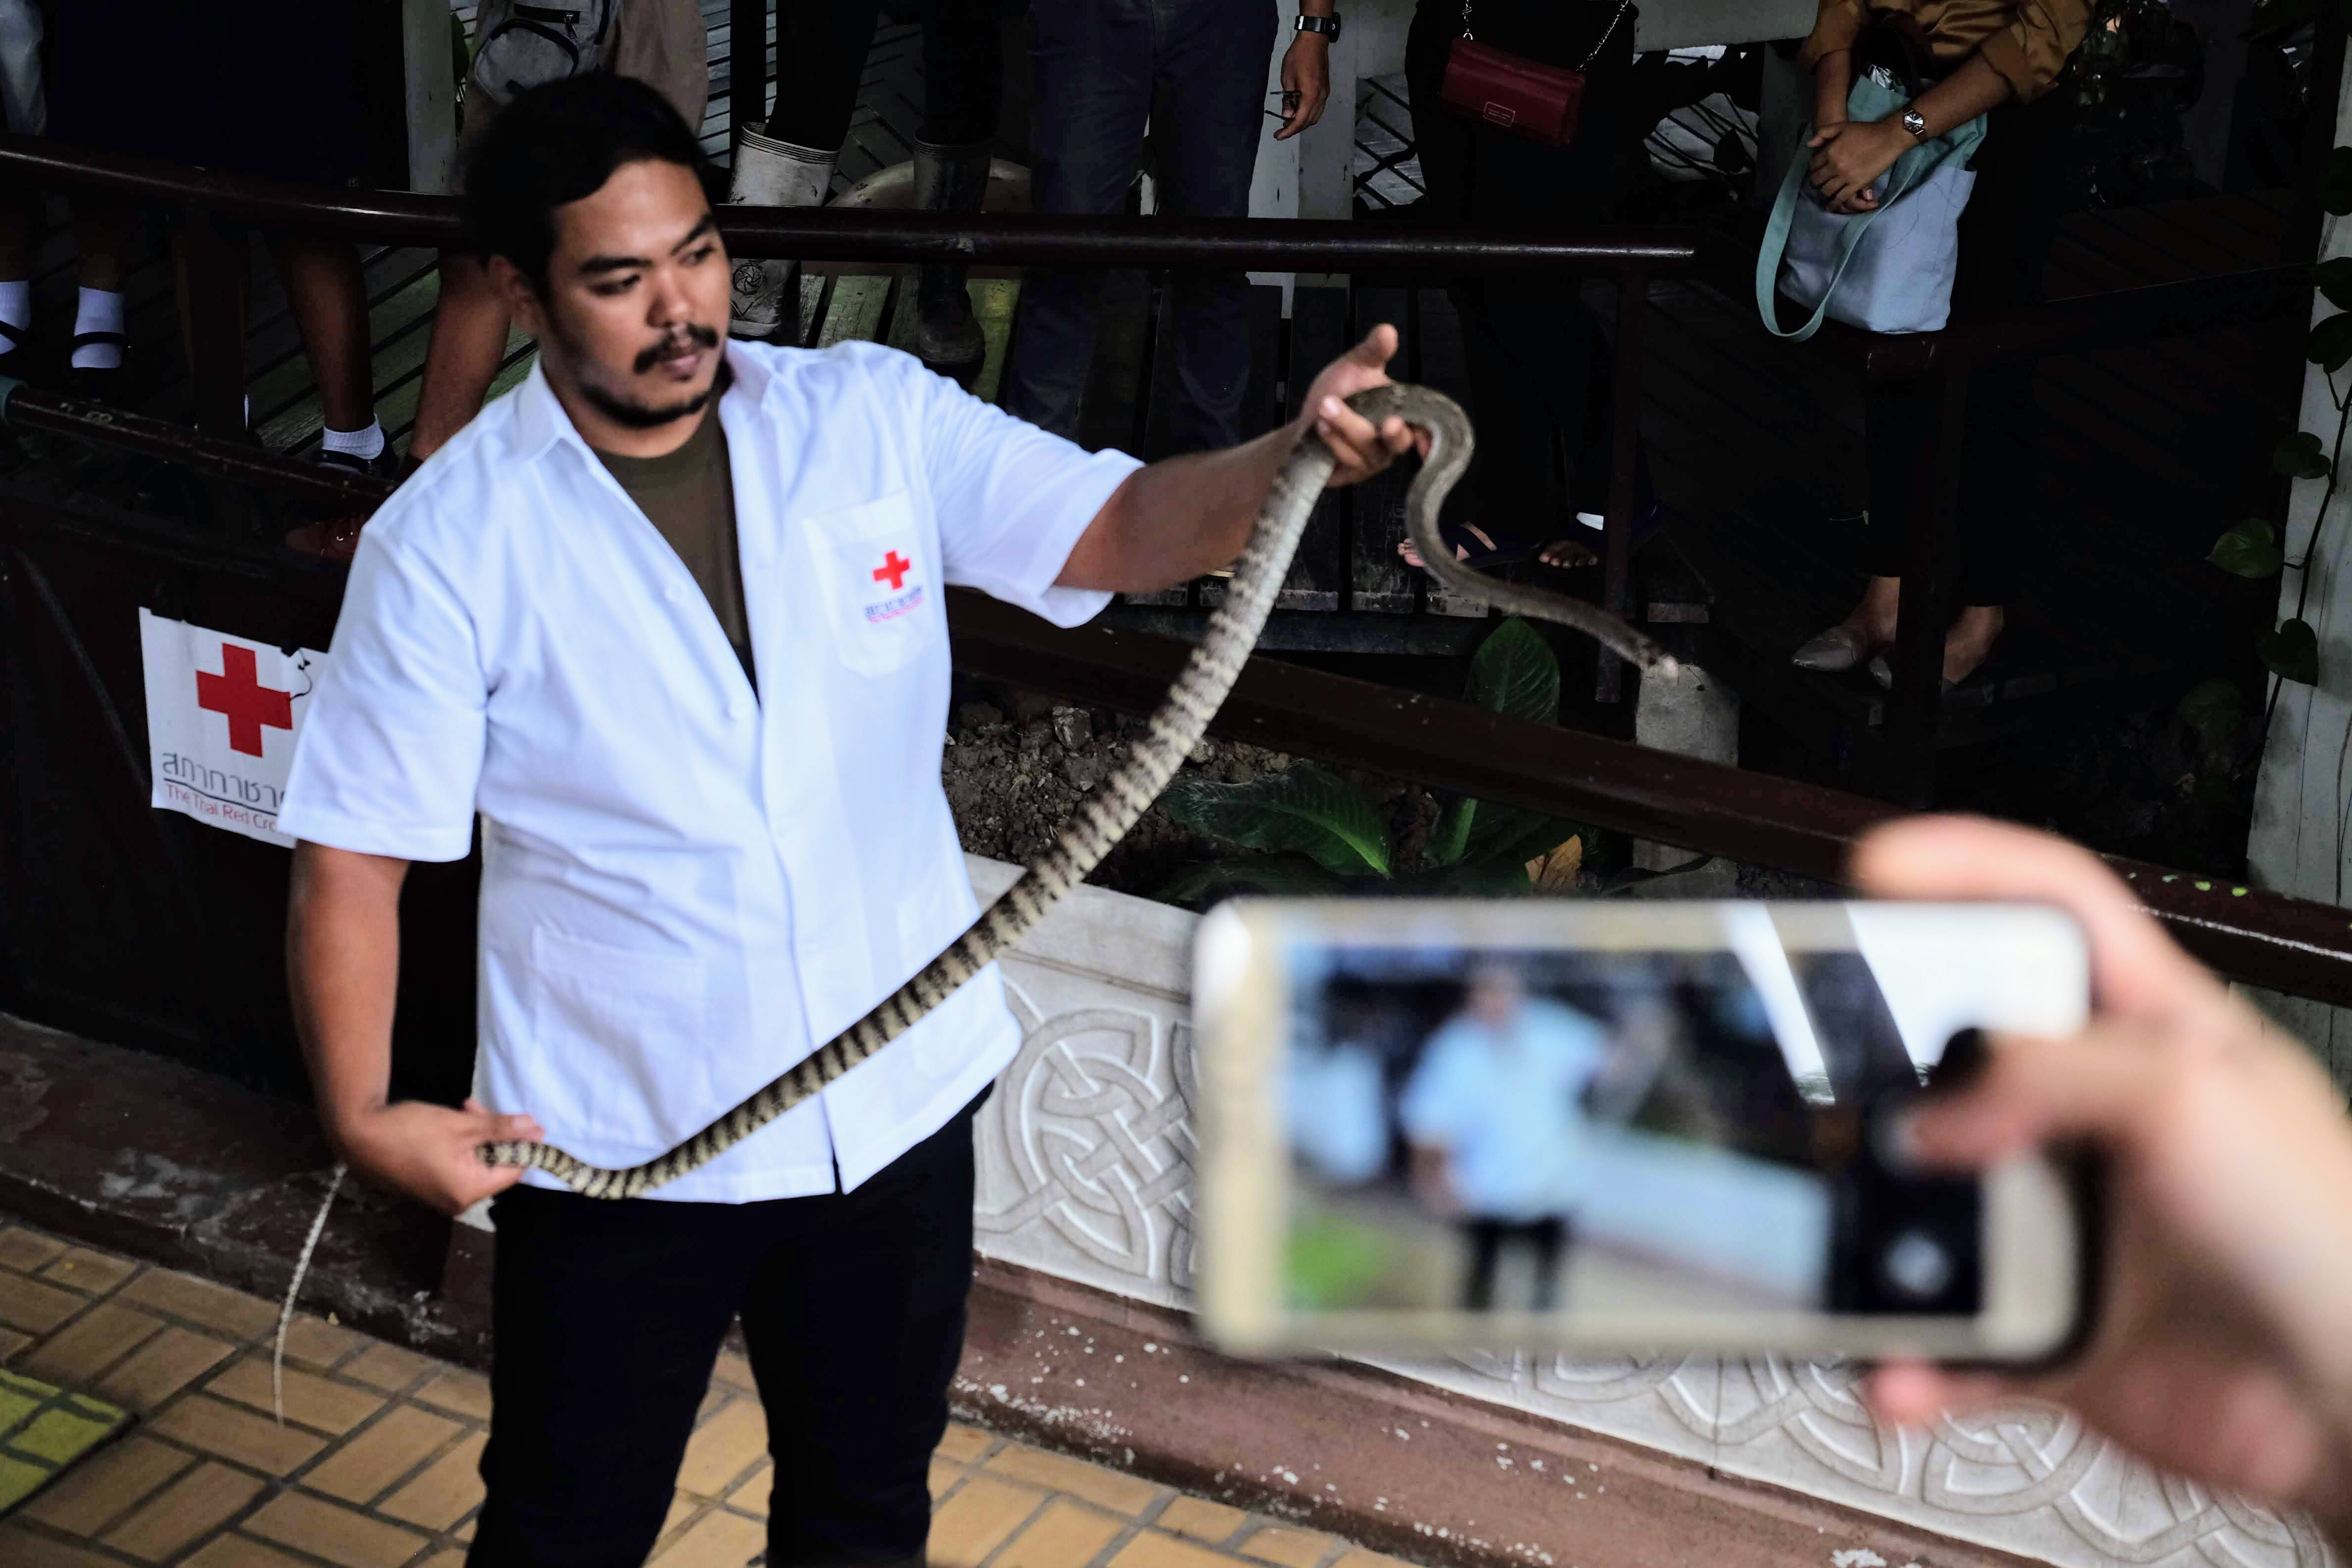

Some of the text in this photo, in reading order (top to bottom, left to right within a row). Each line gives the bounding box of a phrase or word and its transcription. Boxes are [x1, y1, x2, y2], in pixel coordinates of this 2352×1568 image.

[166, 784, 190, 803] The
[194, 794, 218, 815] Thai
[223, 804, 250, 823] Red
